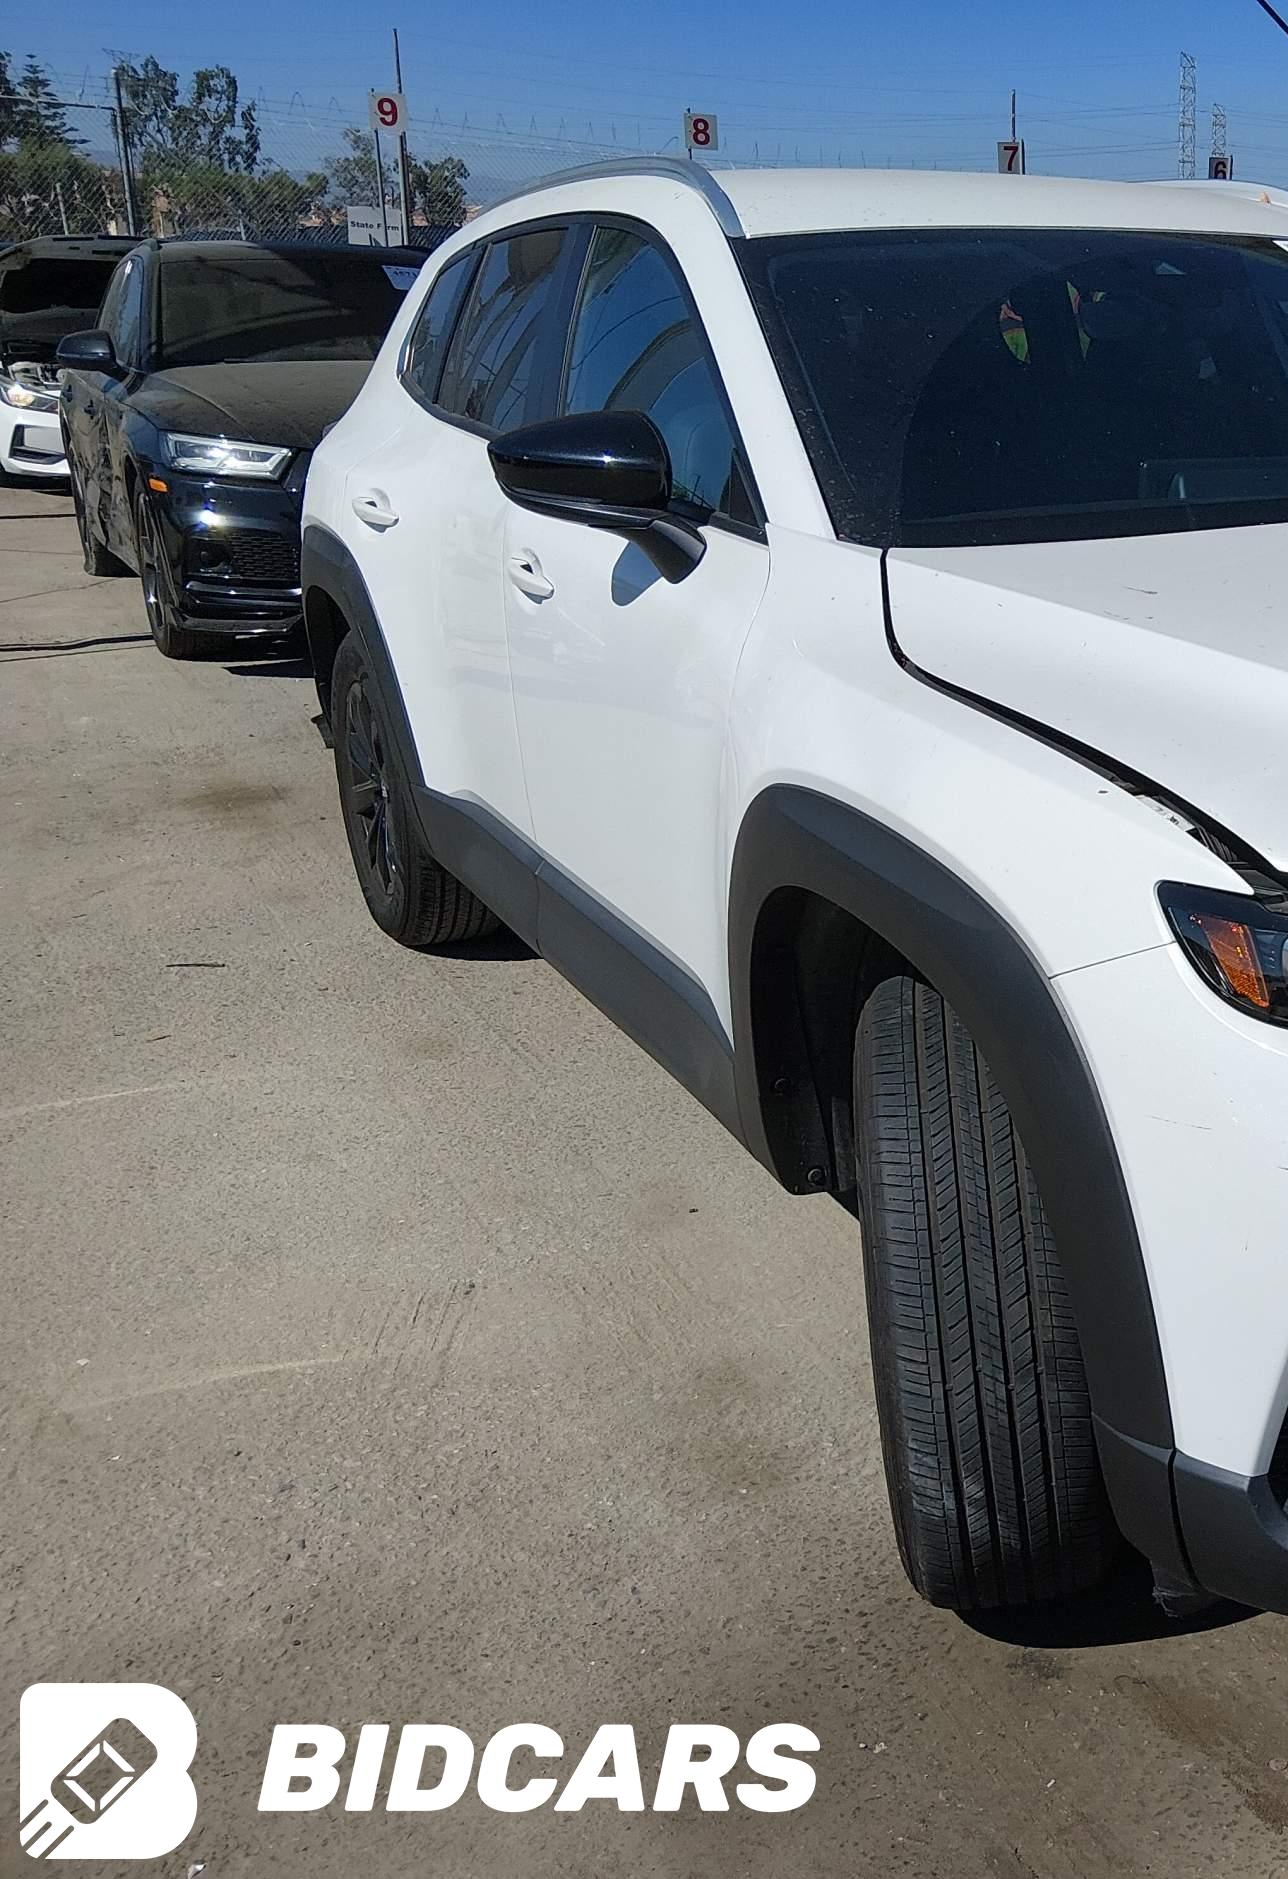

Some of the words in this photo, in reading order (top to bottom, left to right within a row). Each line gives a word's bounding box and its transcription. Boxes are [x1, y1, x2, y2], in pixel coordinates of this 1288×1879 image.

[377, 97, 398, 126] 9
[693, 118, 710, 145] 8
[1003, 145, 1019, 171] 7
[1214, 160, 1227, 180] 6
[350, 221, 374, 230] State
[376, 223, 400, 232] Frm
